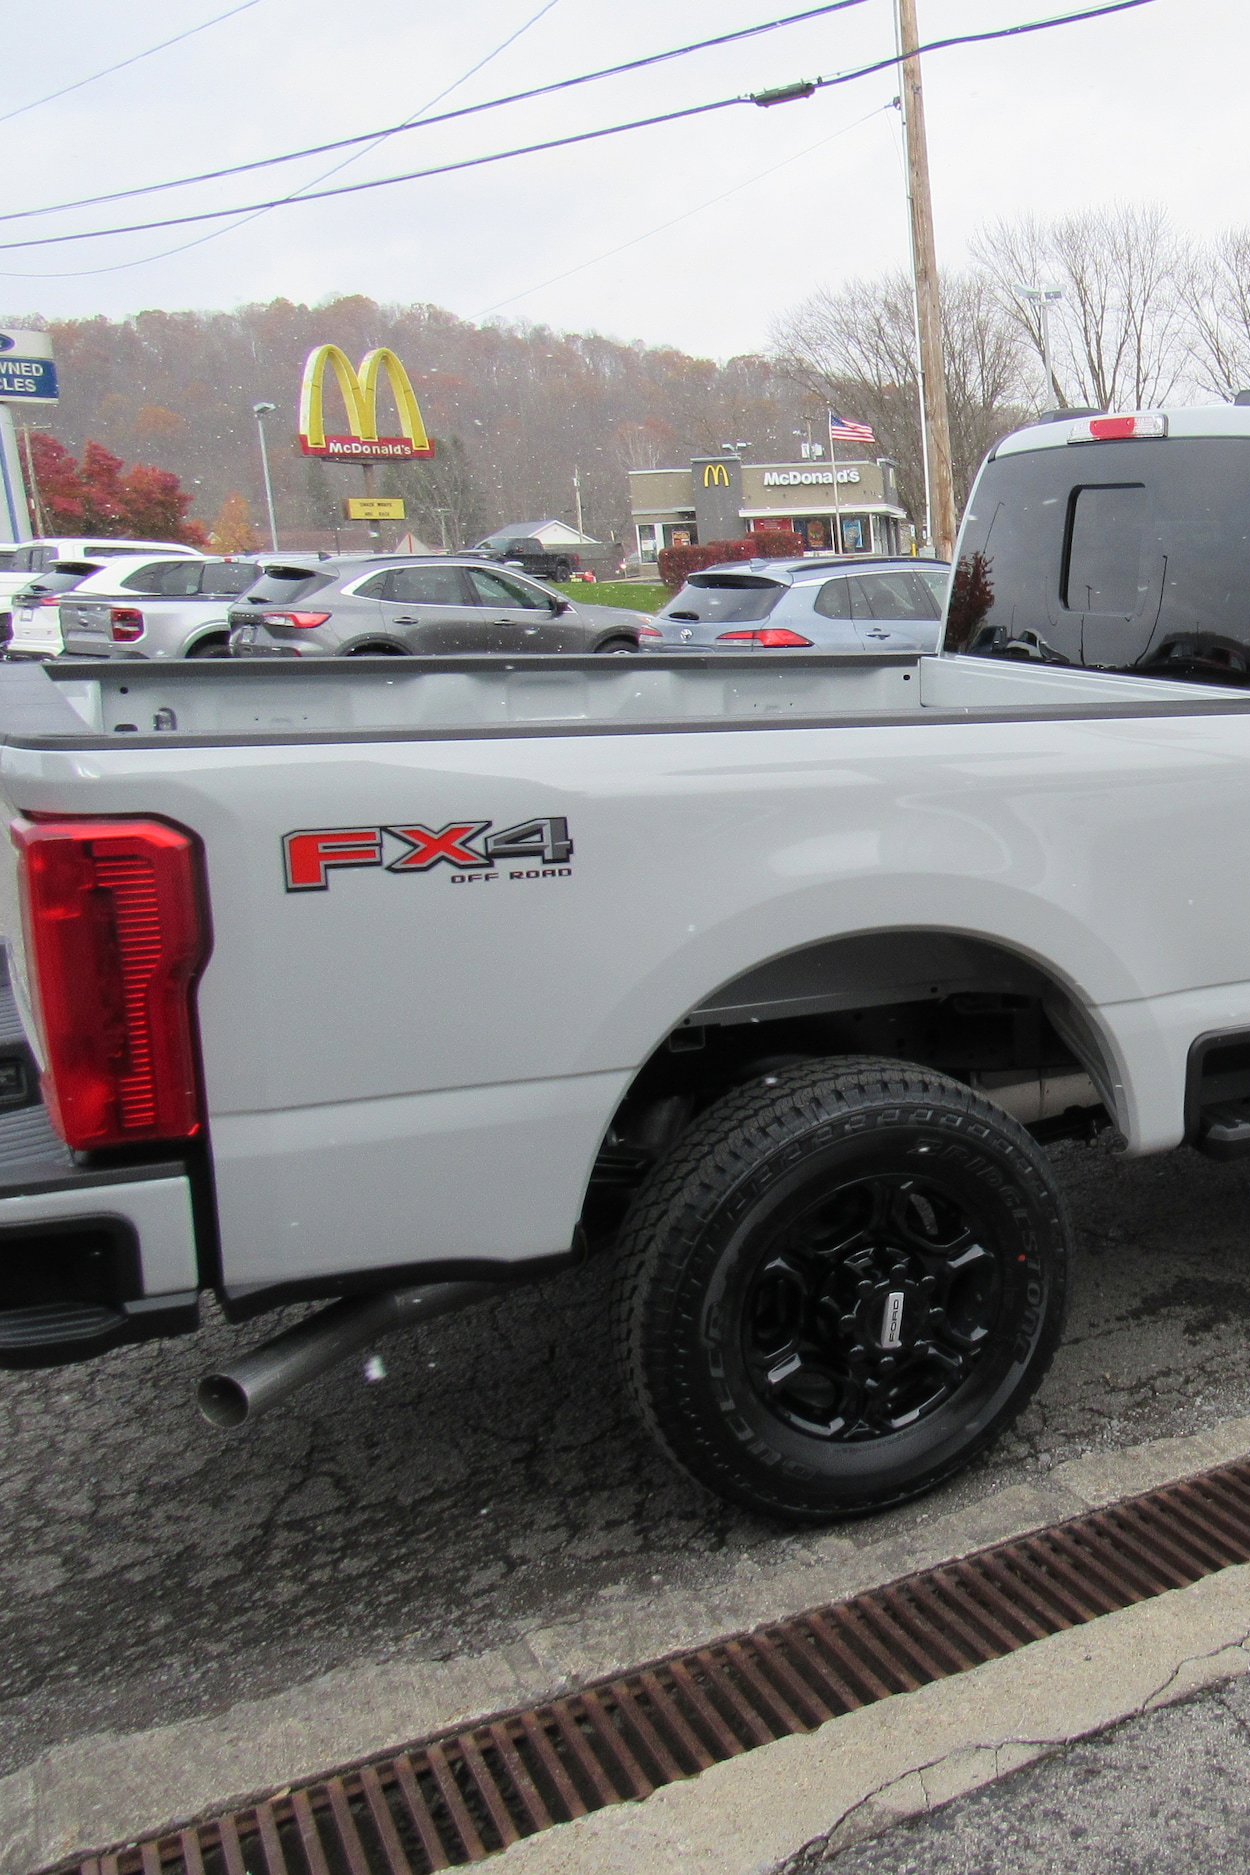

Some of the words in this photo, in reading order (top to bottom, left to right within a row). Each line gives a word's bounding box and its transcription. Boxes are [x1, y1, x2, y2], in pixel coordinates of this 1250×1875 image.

[328, 442, 412, 455] McDonald's
[763, 470, 861, 486] McDonad's
[282, 817, 573, 893] FX4
[450, 871, 499, 884] OFF
[508, 867, 572, 881] ROAD
[888, 1299, 900, 1343] FORD
